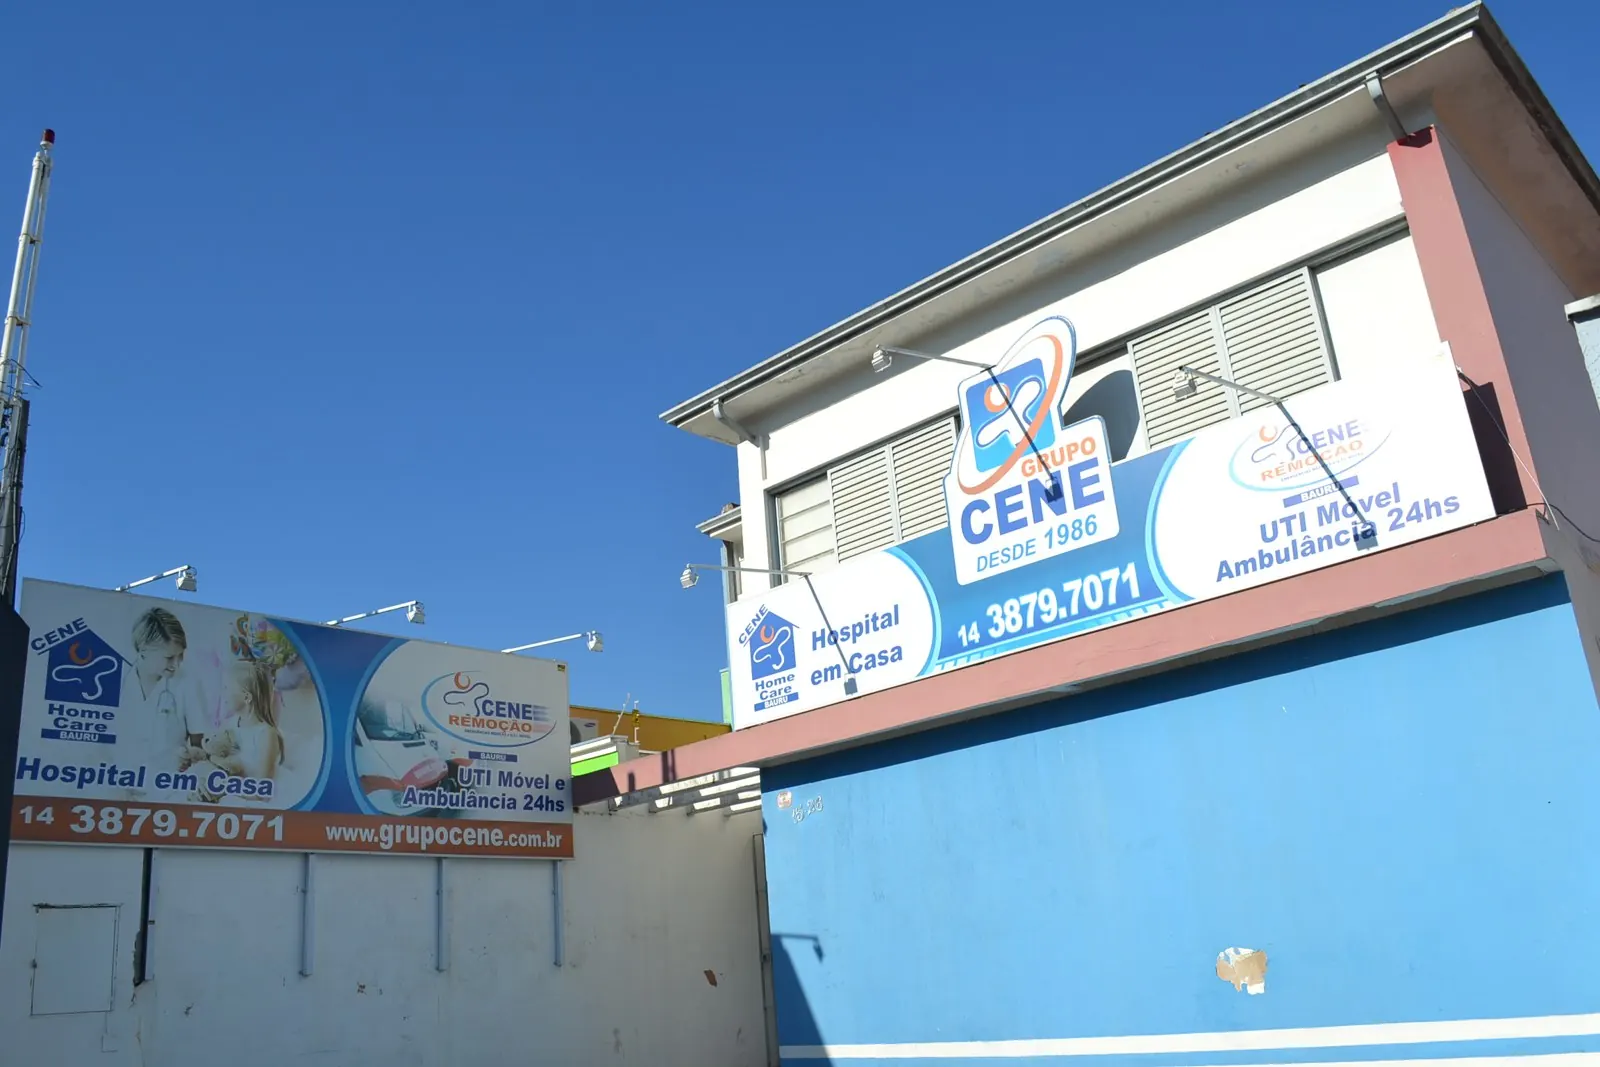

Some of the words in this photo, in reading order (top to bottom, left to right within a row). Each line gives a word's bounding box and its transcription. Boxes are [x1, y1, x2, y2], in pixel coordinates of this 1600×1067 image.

[1297, 419, 1361, 454] CENE
[1021, 436, 1097, 478] GRUPO
[961, 458, 1106, 545] CENE
[977, 538, 1037, 572] DESDE
[1044, 514, 1098, 549] 1986
[1216, 520, 1377, 582] Ambulância
[1387, 494, 1461, 531] 24hs
[1259, 511, 1308, 543] UTI
[958, 621, 981, 647] 14
[986, 562, 1141, 639] 3879.7071
[31, 617, 88, 652] CENE
[738, 604, 769, 645] CENE
[812, 604, 900, 651] Hospital
[755, 673, 795, 691] Home
[811, 662, 842, 686] em
[849, 645, 903, 674] Casa
[759, 684, 792, 701] Care
[764, 695, 789, 708] BAURU
[48, 703, 115, 720] Home
[53, 716, 108, 733] Care
[482, 699, 533, 721] CENE
[59, 731, 99, 742] BAURU
[480, 752, 506, 762] BAURU
[16, 756, 146, 789] Hospital
[155, 772, 197, 791] em
[207, 771, 273, 796] Casa
[459, 767, 491, 788] UTI
[500, 769, 549, 790] Móvel
[555, 779, 565, 790] e
[403, 786, 516, 811] Ambulância
[523, 795, 565, 812] 24hs
[19, 805, 54, 824] 14
[70, 805, 284, 841] 3879.7071
[326, 822, 562, 850] www.grupocene.com.br
